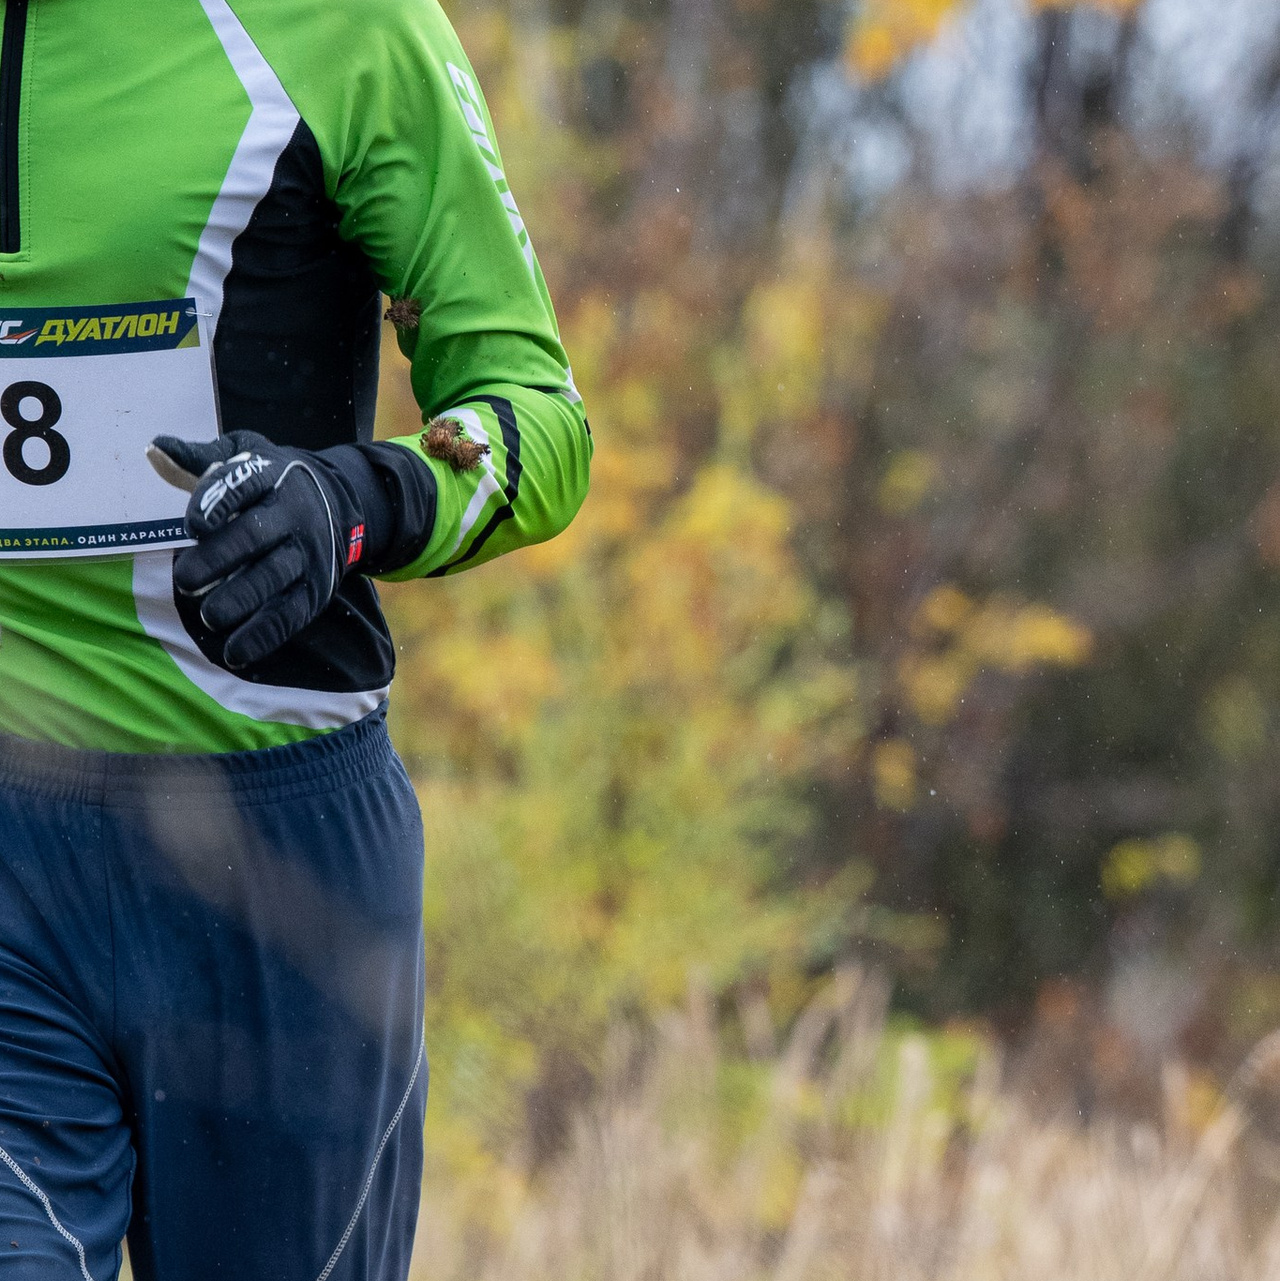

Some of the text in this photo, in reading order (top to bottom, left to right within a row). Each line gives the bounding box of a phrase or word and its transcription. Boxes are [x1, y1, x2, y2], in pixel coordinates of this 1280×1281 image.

[34, 311, 180, 347] ДУАТЛОН
[0, 380, 71, 486] 8
[25, 537, 74, 546] ЭТАПА.
[78, 534, 116, 545] ОДИН
[120, 527, 187, 541] ХАРАКТЕ
